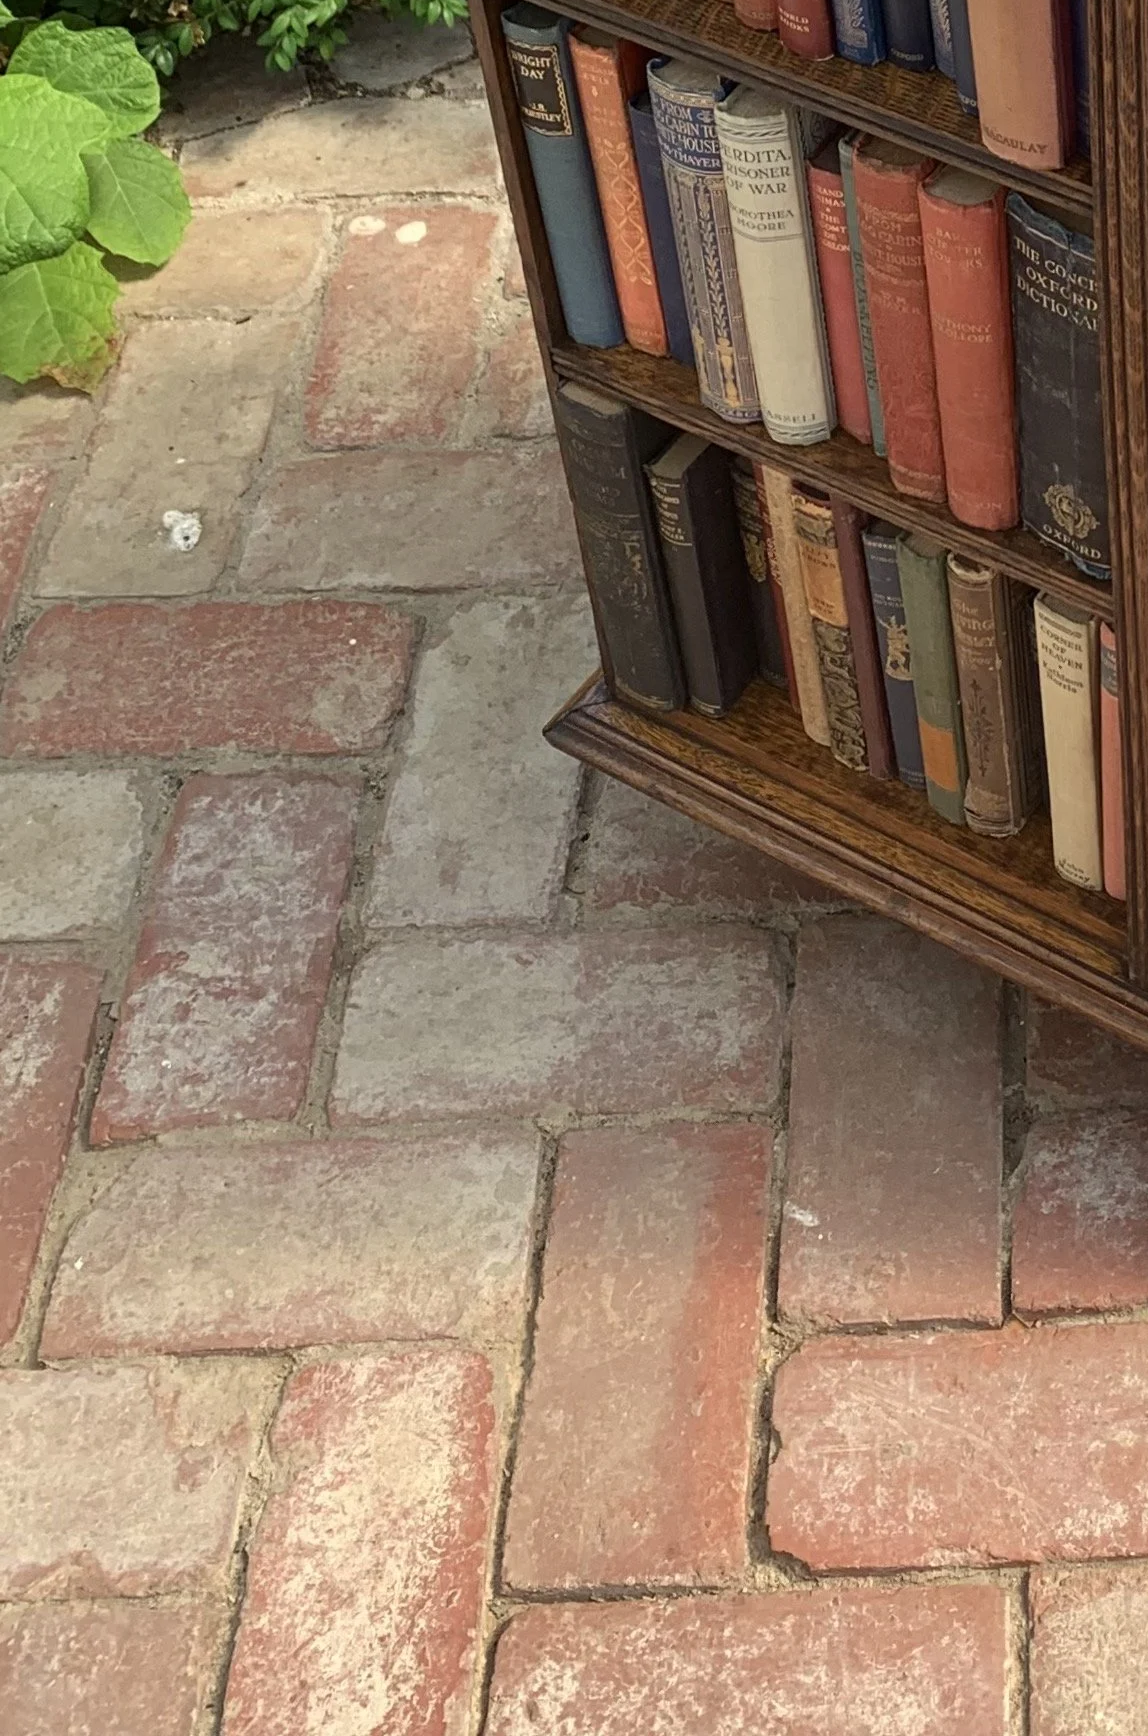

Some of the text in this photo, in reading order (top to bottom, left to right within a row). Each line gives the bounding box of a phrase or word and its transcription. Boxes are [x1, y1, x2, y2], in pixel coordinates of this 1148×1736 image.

[520, 66, 546, 80] DAY
[659, 97, 693, 121] FROM
[665, 114, 700, 139] CABIN
[678, 134, 721, 155] HOUSE
[672, 147, 722, 168] THAYER
[727, 175, 788, 196] OF WAR
[736, 216, 787, 232] MOORE
[1014, 236, 1040, 265] THE
[1025, 266, 1099, 312] OXFORD
[1042, 524, 1101, 560] OXFORD
